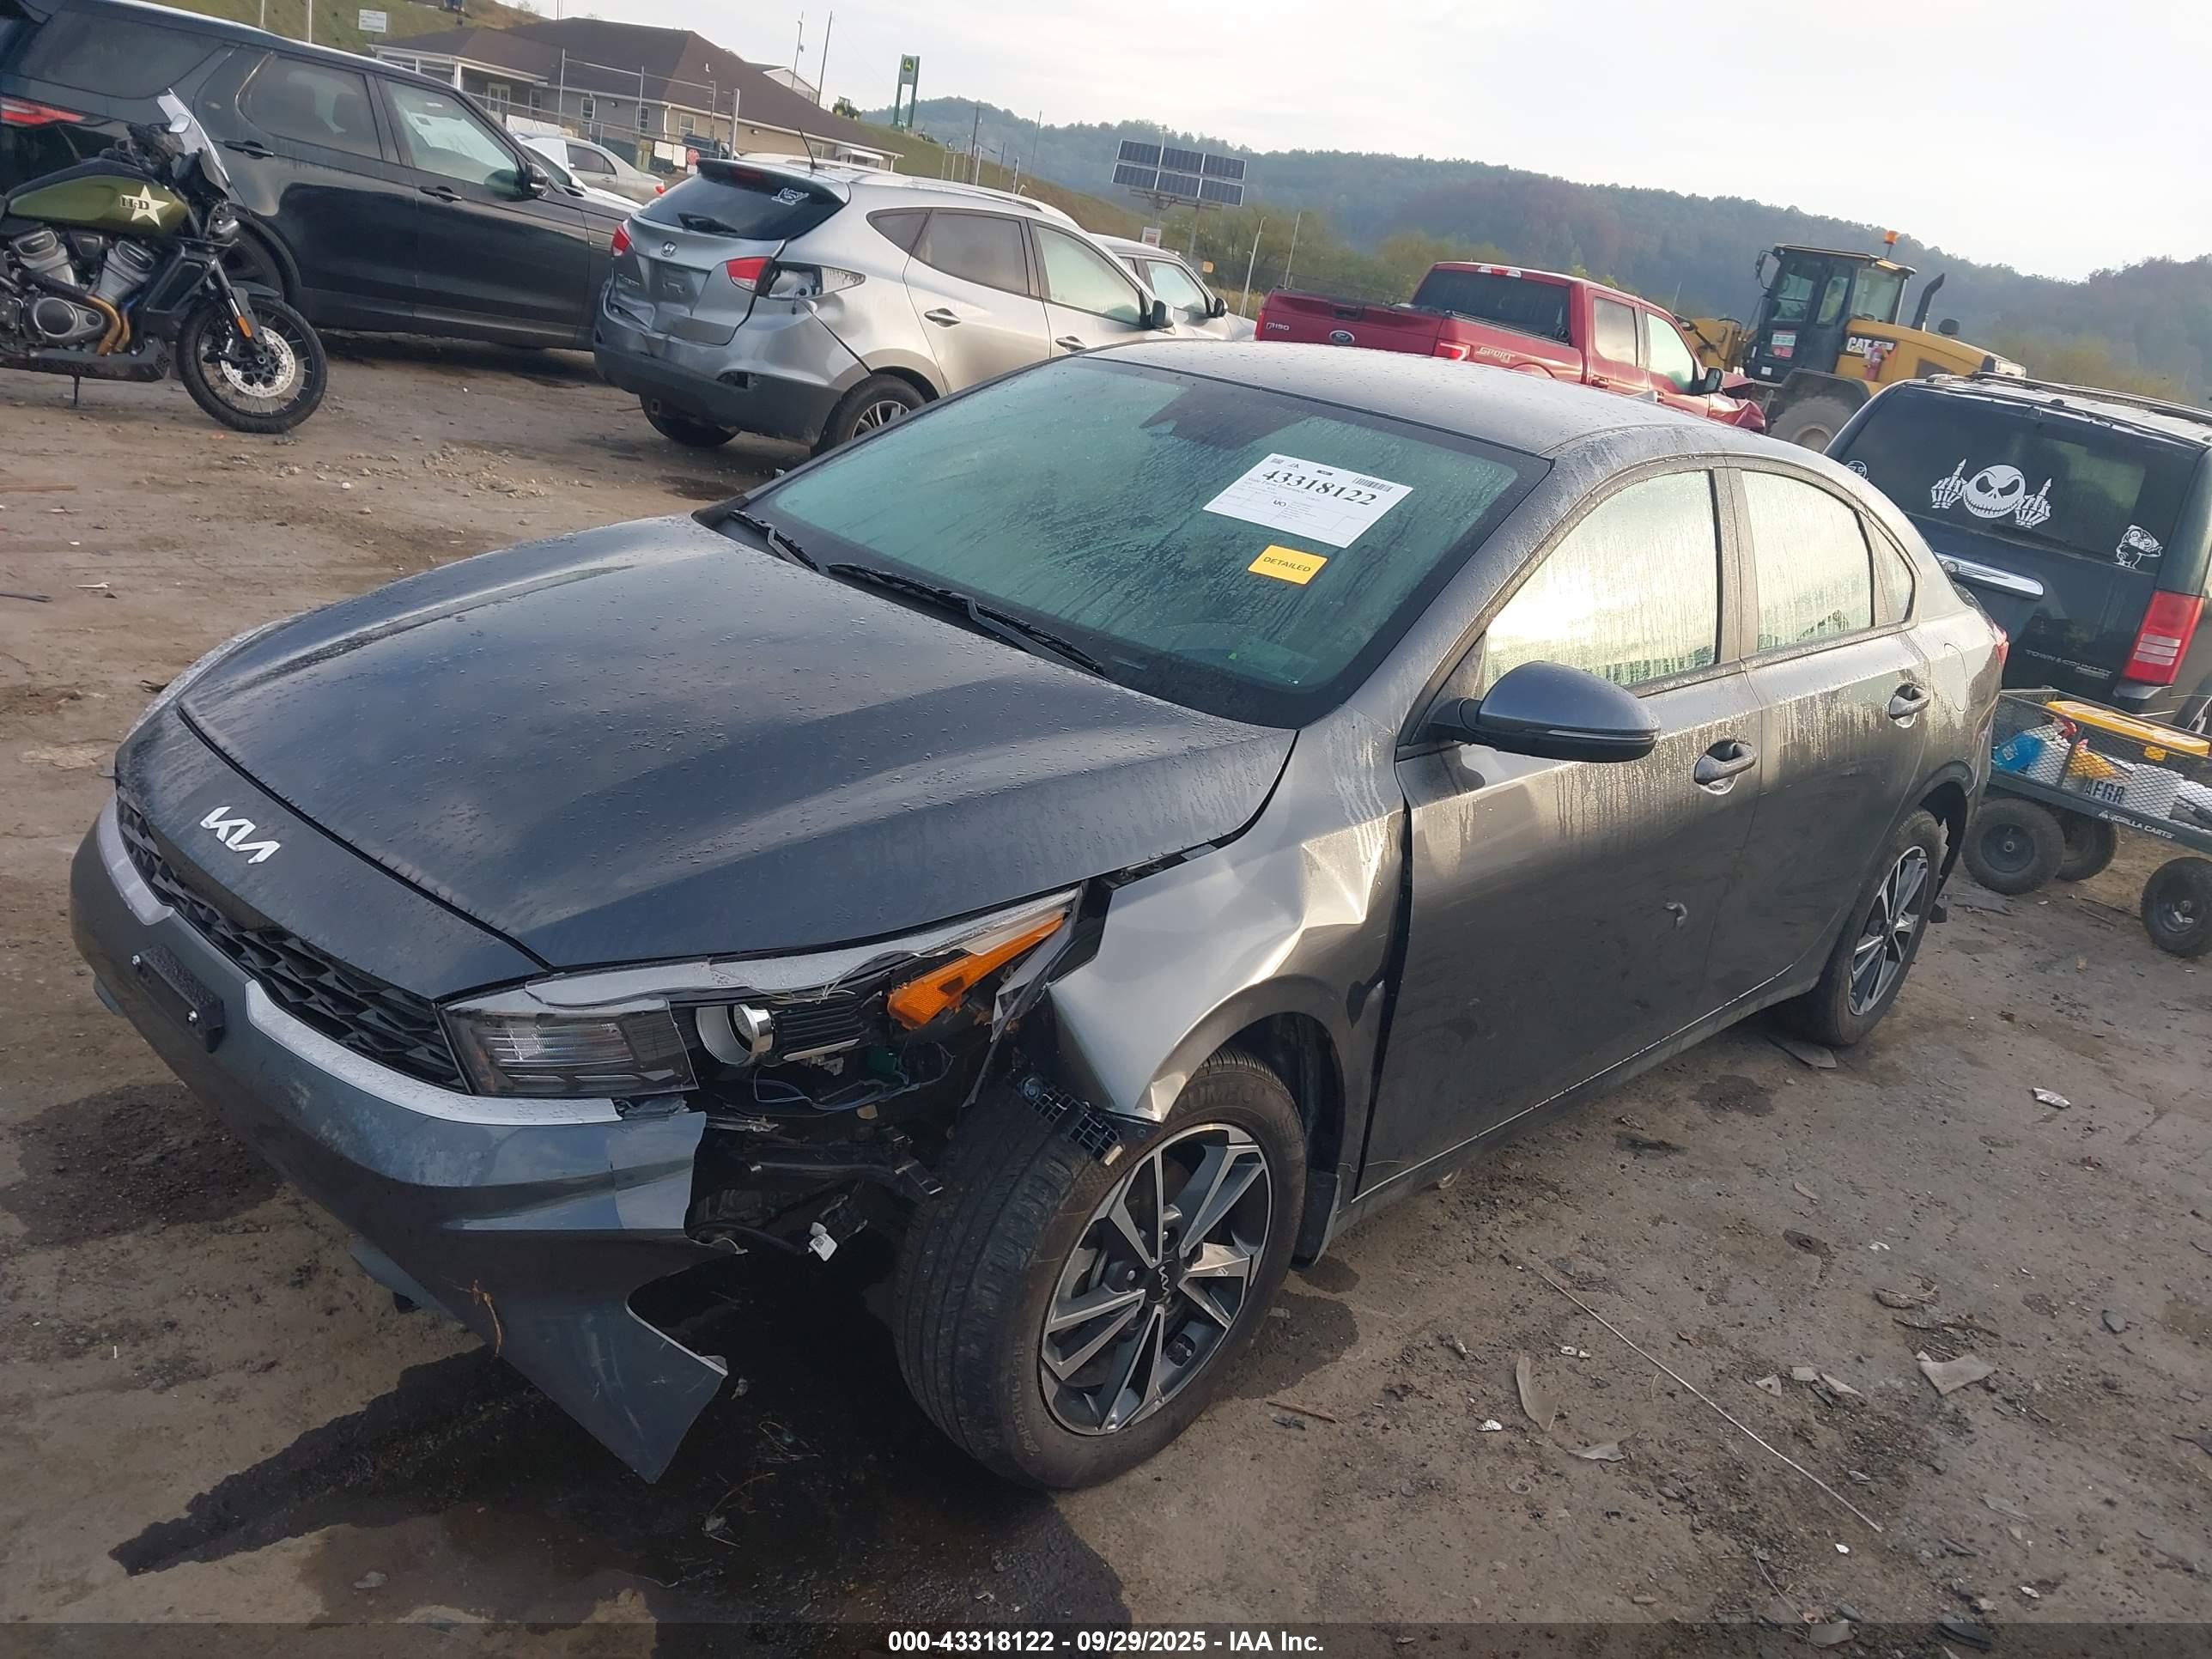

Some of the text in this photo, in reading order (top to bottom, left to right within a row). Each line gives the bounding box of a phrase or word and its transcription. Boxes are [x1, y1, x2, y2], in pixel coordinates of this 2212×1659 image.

[1846, 337, 1872, 356] CAT
[1262, 470, 1378, 506] 43318122
[1263, 556, 1311, 572] DETAILED
[200, 806, 281, 864] KIA
[2143, 825, 2176, 840] CARTS
